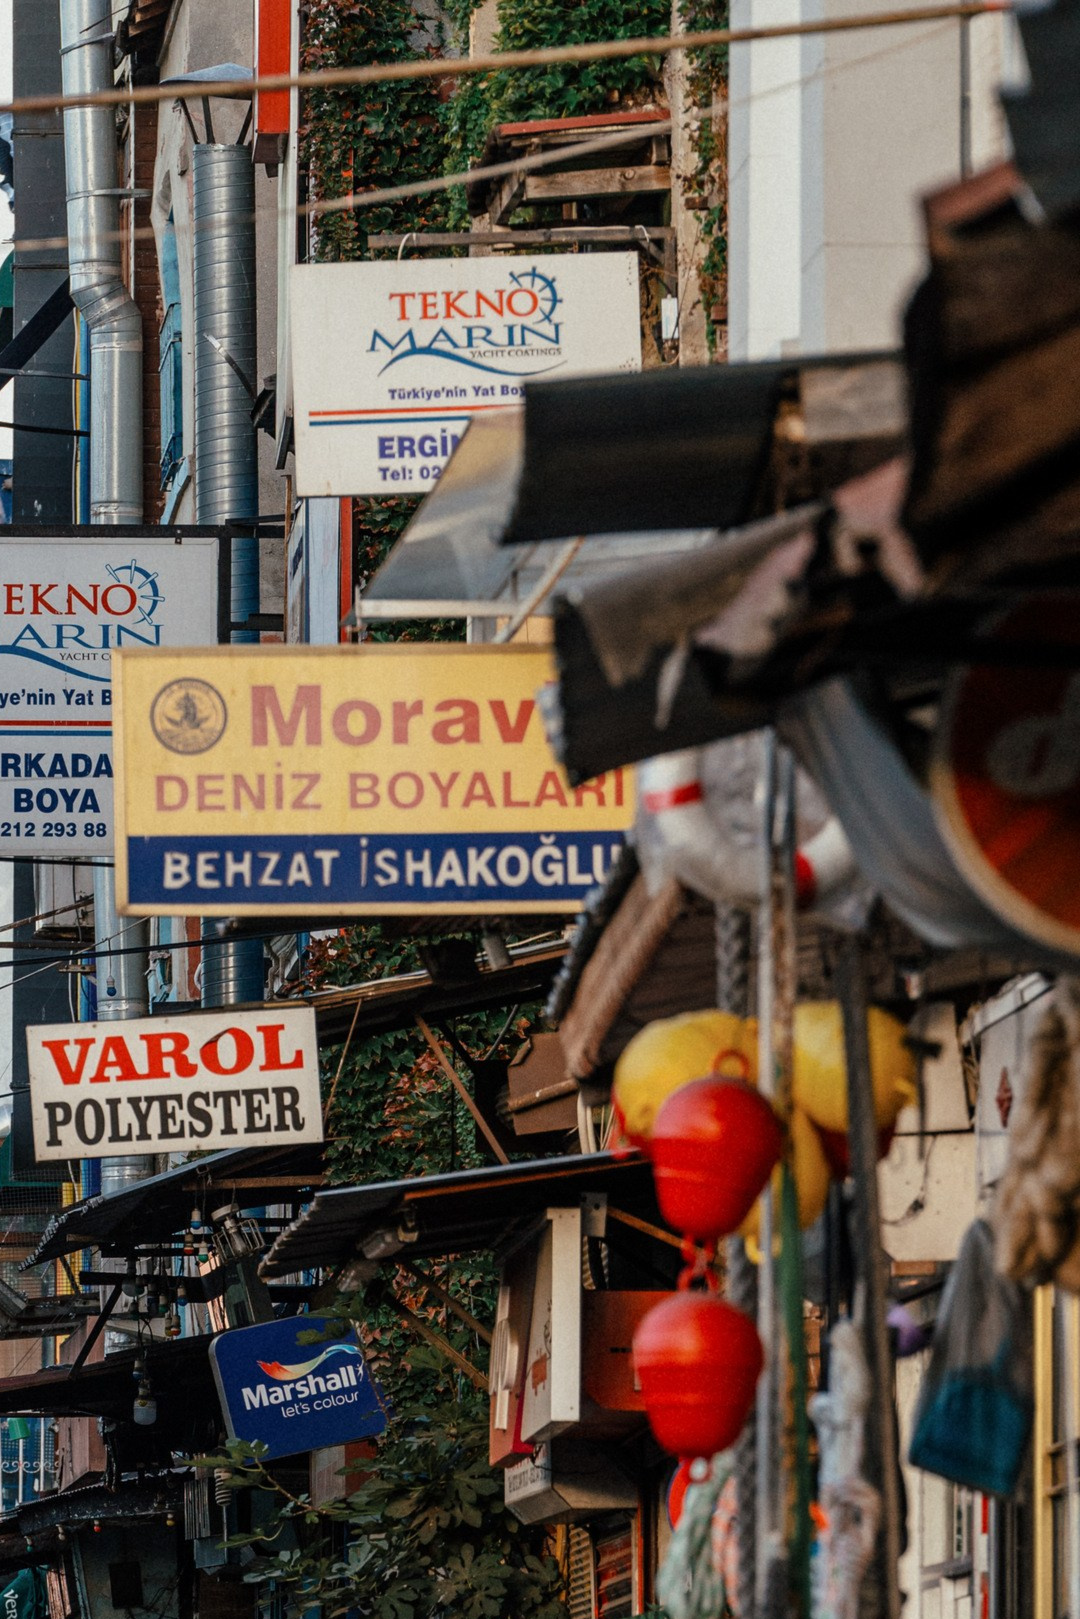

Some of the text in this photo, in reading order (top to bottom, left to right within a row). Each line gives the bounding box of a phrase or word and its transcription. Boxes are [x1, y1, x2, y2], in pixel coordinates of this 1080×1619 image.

[389, 288, 539, 321] TEKNO
[366, 322, 564, 352] MARIN
[470, 347, 562, 359] YACHT COATINGS
[388, 386, 467, 401] Türkiye'nin
[472, 385, 496, 398] Yat
[378, 466, 413, 481] Tel:
[59, 652, 99, 661] YACHT
[62, 689, 94, 706] Yat
[250, 682, 556, 748] Morav
[13, 787, 101, 813] BOYA
[155, 763, 323, 812] DENİZ
[42, 821, 77, 837] 293
[83, 822, 107, 837] 88
[162, 847, 341, 891] BEHZAT
[41, 1023, 305, 1086] VAROL
[43, 1086, 305, 1147] POLYESTER
[241, 1365, 357, 1411] Marshall
[281, 1391, 359, 1418] let's colour
